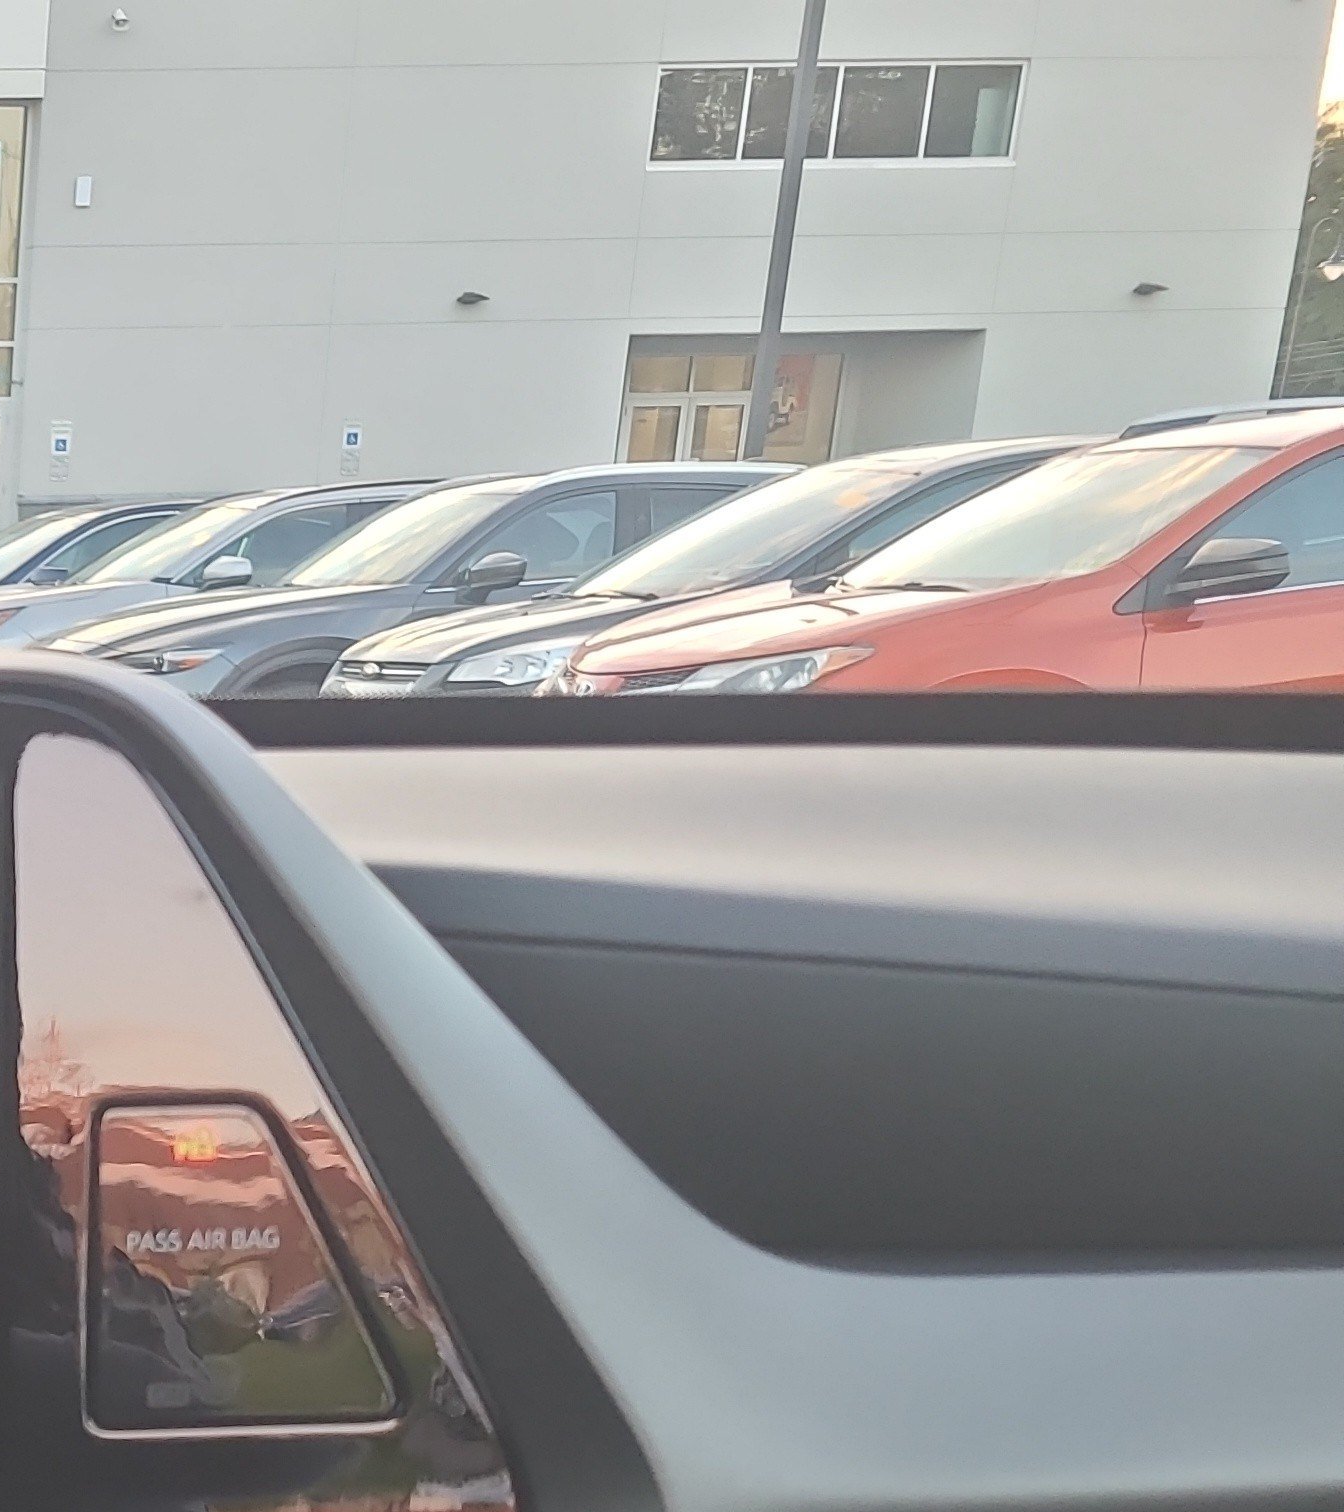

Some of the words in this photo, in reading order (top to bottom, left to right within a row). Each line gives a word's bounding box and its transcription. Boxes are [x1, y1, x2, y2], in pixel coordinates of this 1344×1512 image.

[126, 1227, 183, 1253] PASS
[186, 1226, 226, 1251] AIR
[230, 1223, 280, 1250] BAG
